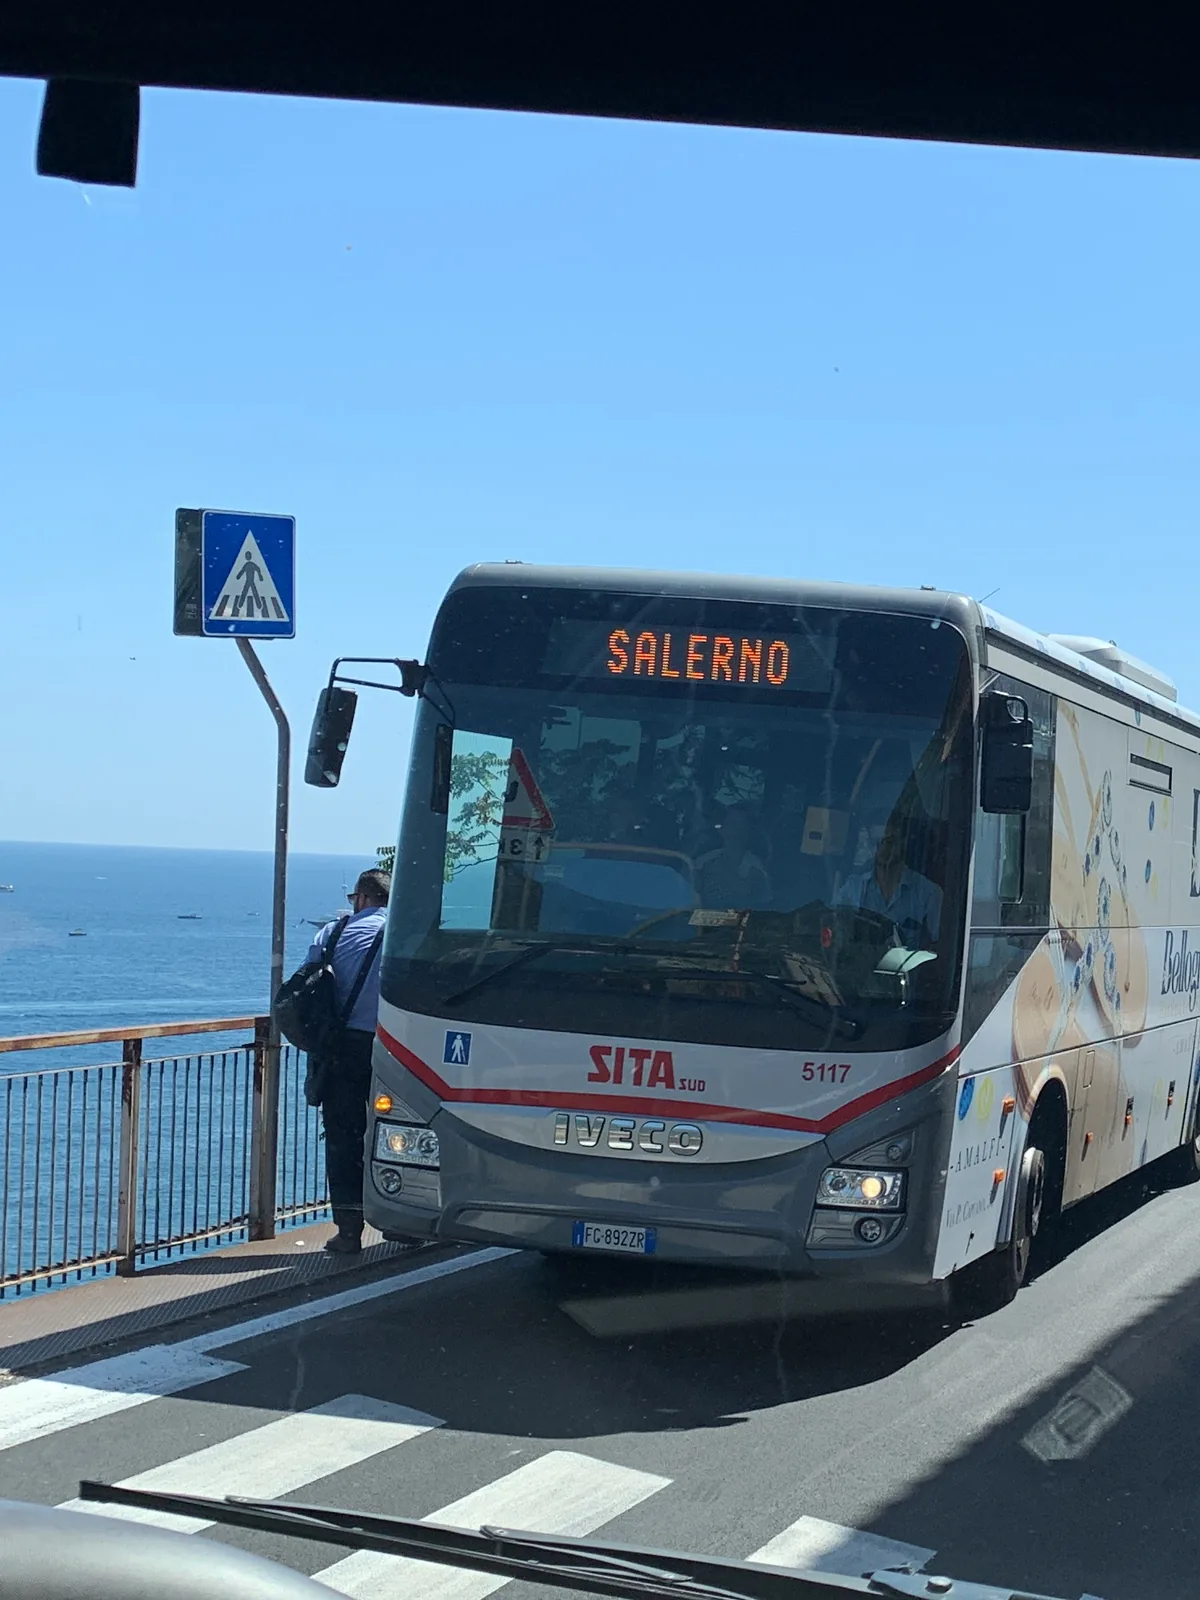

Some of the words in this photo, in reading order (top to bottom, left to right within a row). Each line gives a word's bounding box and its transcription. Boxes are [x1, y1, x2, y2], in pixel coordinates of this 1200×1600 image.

[606, 628, 791, 685] SALERNO
[587, 1044, 676, 1090] SITA
[679, 1077, 707, 1093] SUD
[801, 1061, 852, 1085] 5117
[554, 1113, 704, 1156] IVECO
